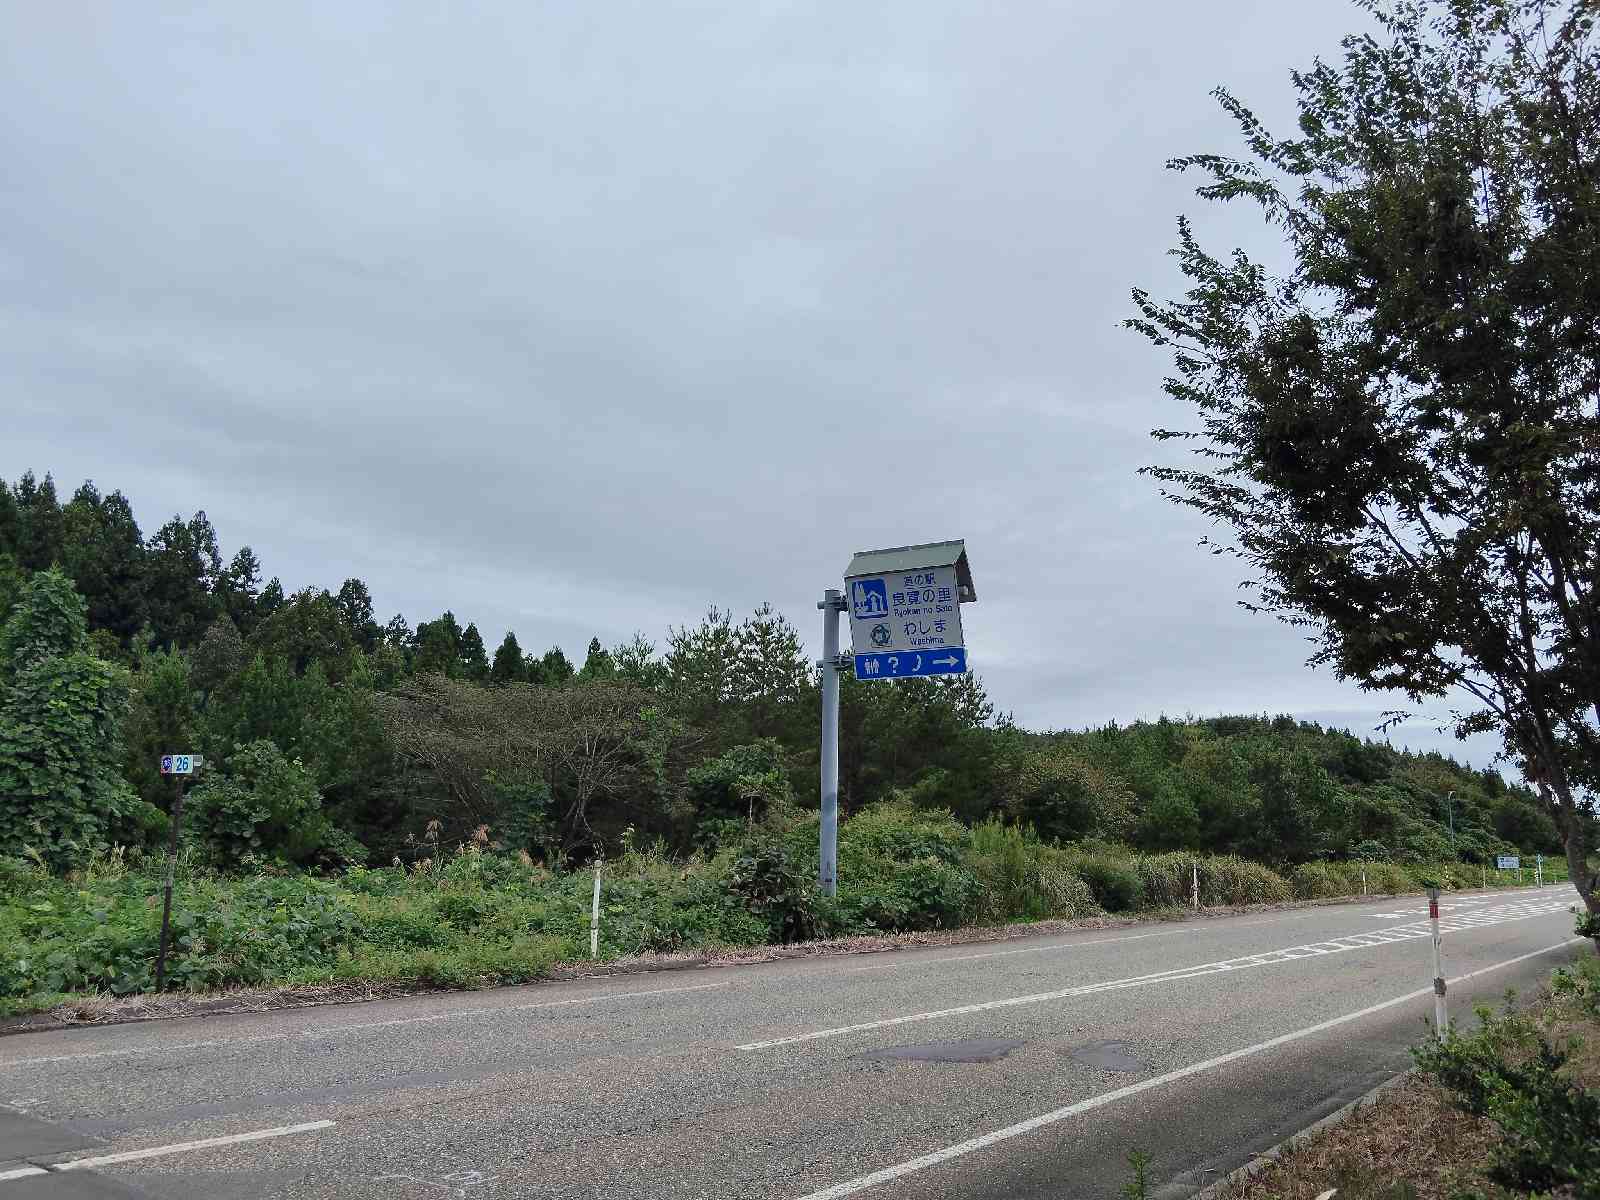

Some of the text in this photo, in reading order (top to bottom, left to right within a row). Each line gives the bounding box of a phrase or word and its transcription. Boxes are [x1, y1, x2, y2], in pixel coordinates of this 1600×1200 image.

[903, 619, 947, 636] わしま
[910, 636, 945, 646] Washima
[175, 756, 189, 772] 26
